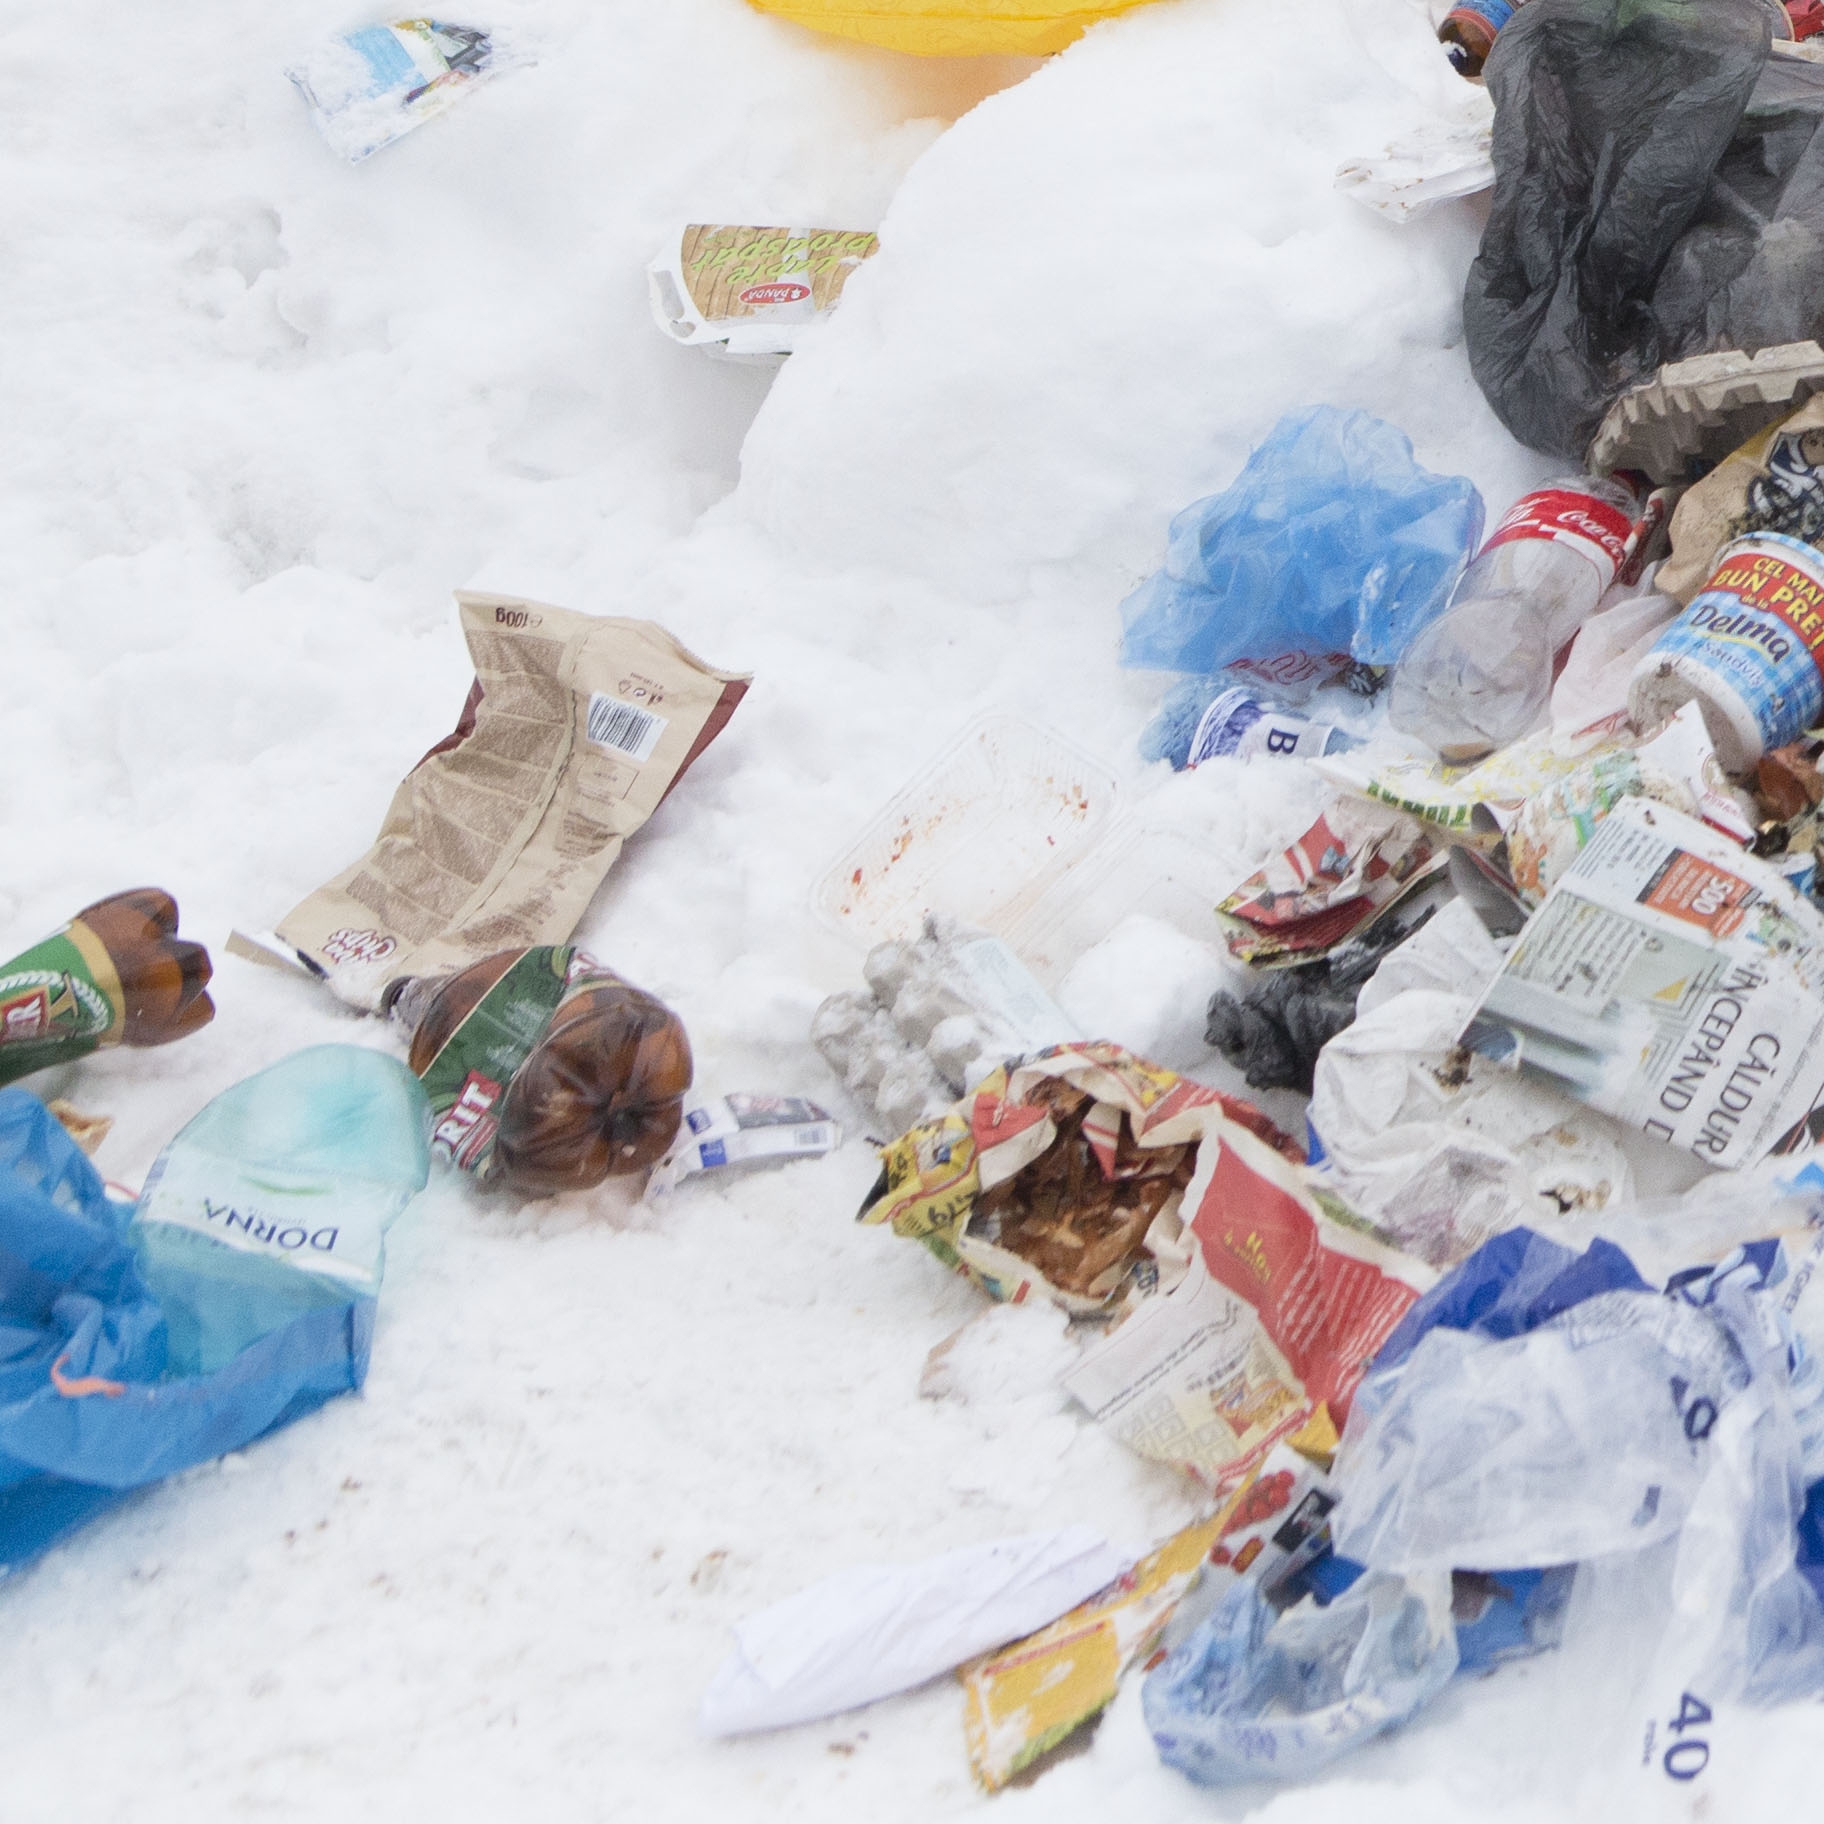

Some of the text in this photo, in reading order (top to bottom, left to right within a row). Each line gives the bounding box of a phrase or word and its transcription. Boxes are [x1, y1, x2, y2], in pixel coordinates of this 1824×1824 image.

[1714, 567, 1765, 608] BUN
[1752, 555, 1784, 582] CEL
[1690, 603, 1792, 665] Delma
[1690, 874, 1735, 916] 500
[200, 1194, 341, 1254] DORNA
[1661, 1692, 1714, 1782] 40
